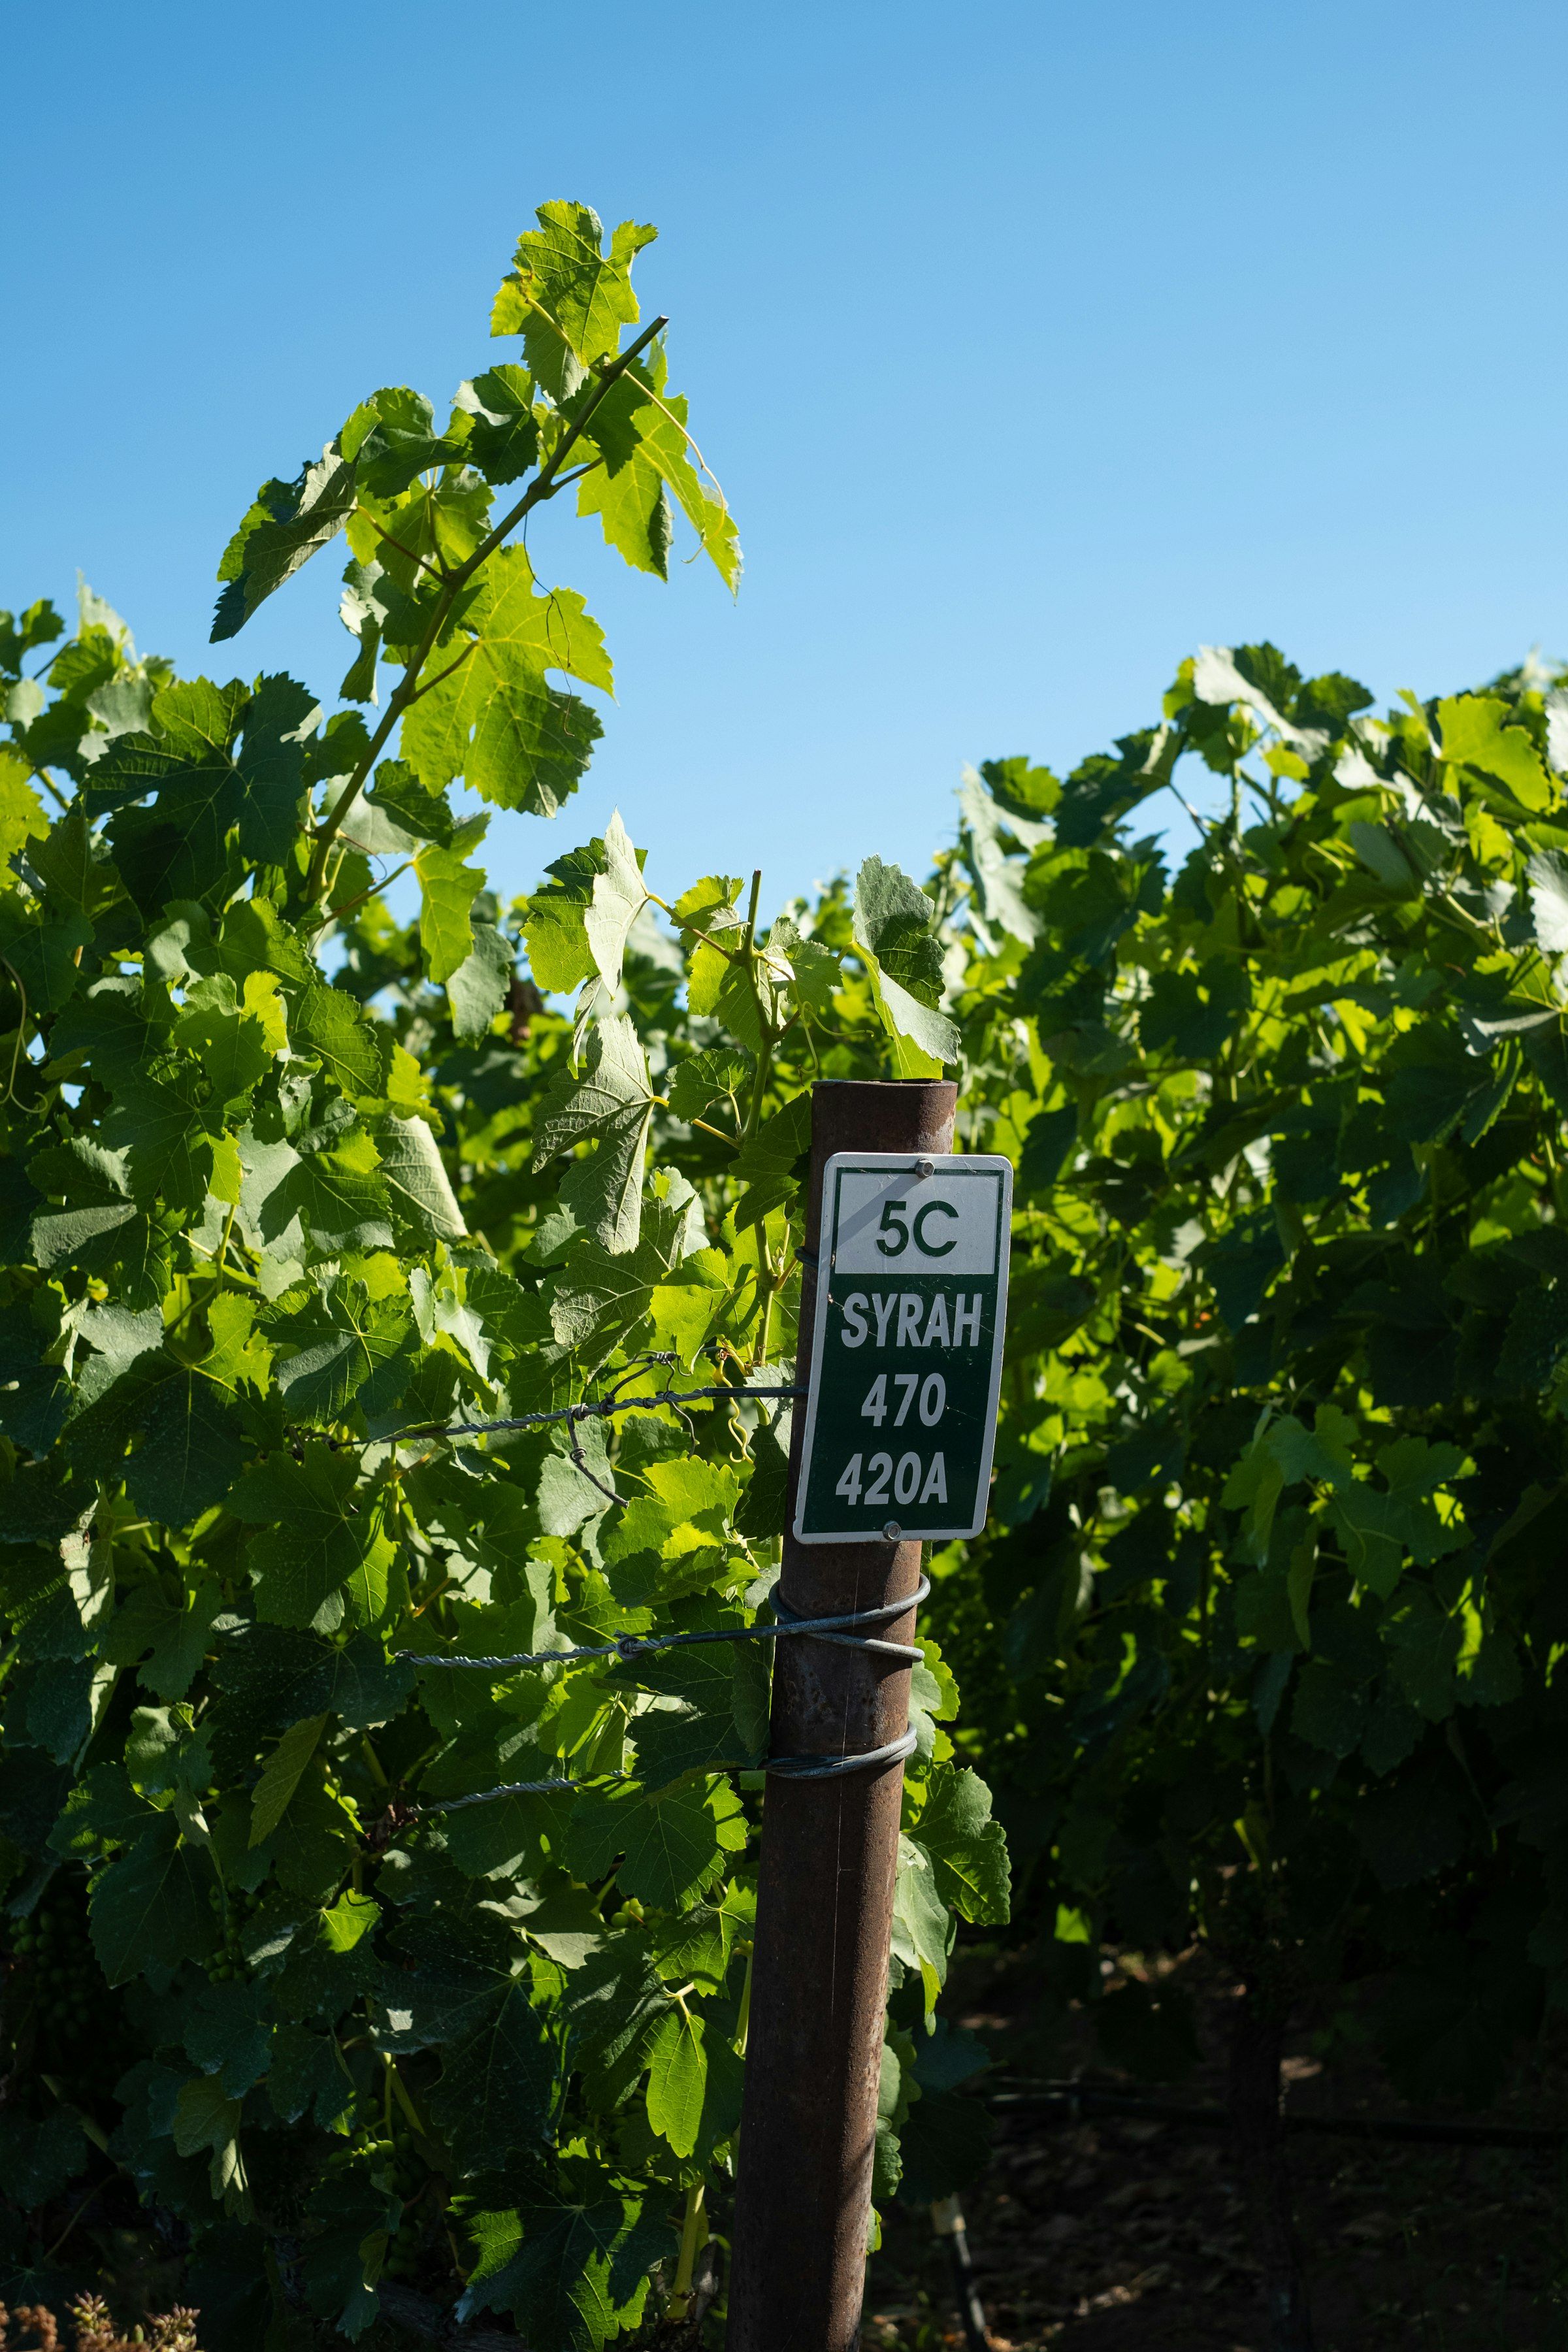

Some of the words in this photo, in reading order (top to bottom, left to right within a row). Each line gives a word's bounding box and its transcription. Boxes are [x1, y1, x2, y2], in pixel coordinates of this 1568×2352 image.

[876, 1201, 959, 1257] 5C
[841, 1292, 983, 1348] SYRAH
[861, 1373, 946, 1427] 470
[836, 1452, 948, 1505] 420A
